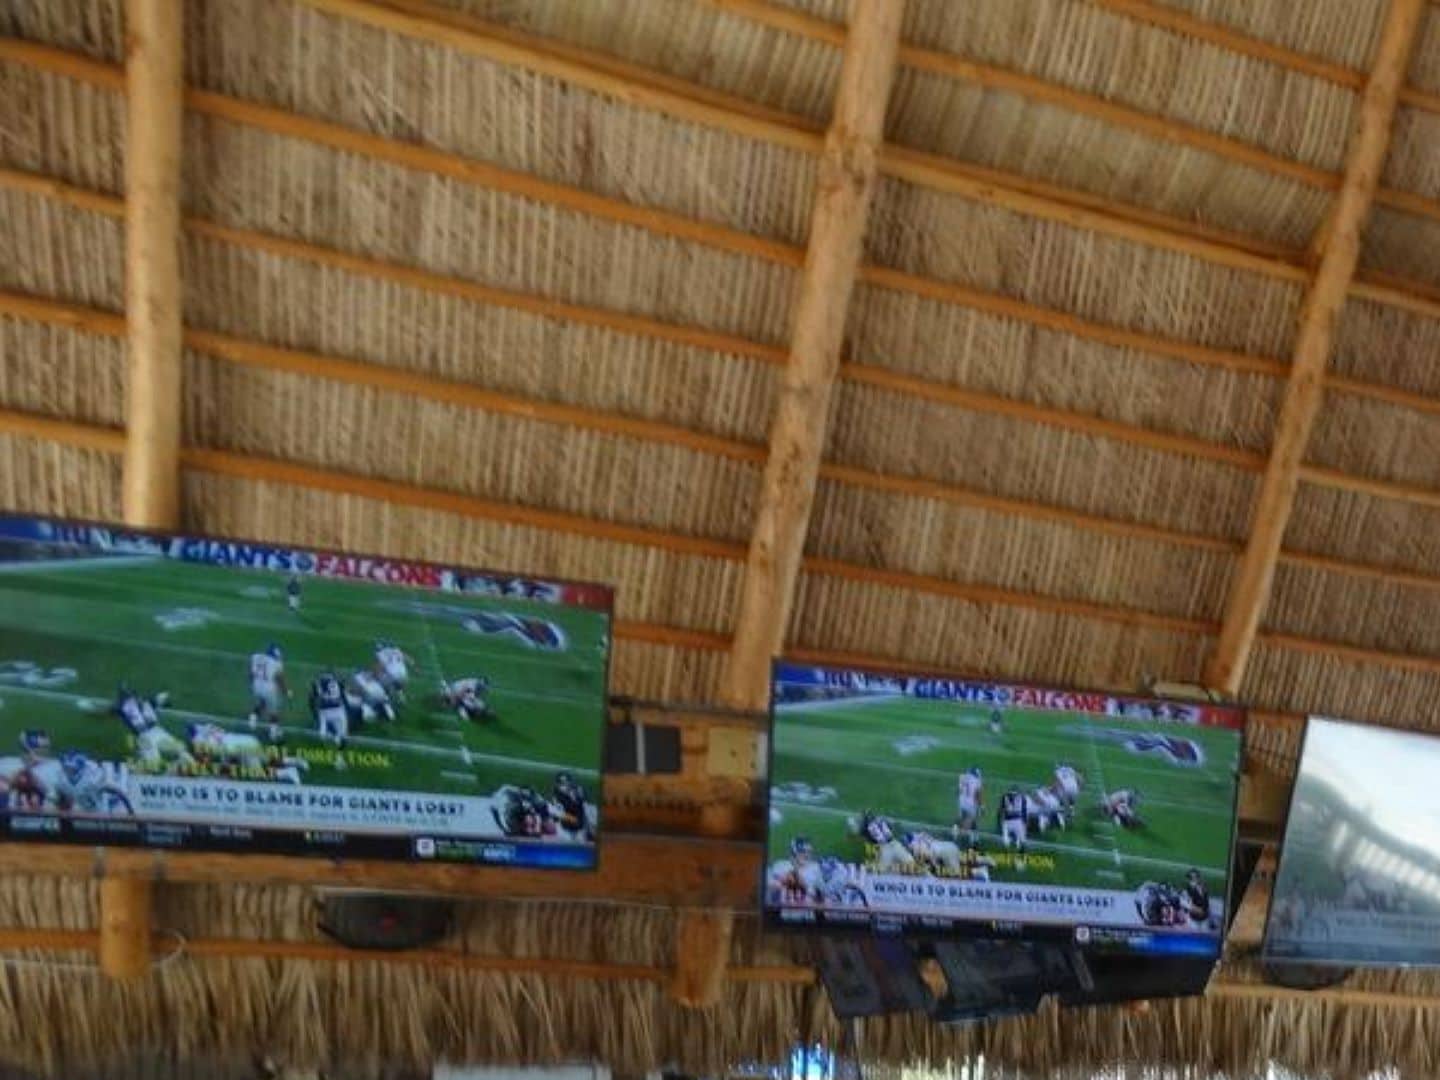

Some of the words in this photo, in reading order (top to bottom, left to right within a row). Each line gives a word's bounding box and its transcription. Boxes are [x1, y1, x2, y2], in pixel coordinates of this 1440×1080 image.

[186, 539, 294, 570] GIANTS
[315, 555, 441, 590] FALCONS
[917, 680, 997, 702] GIANTS
[1013, 687, 1107, 714] FALCONS
[140, 783, 186, 799] WHO
[192, 787, 209, 801] IS
[216, 787, 239, 802] TO
[246, 790, 302, 807] BLAME
[308, 793, 344, 809] FOR
[350, 795, 410, 813] GIANTS
[873, 882, 907, 894] WHO
[911, 884, 923, 896] IS
[928, 885, 945, 897] TO
[950, 886, 992, 900] BLAME
[996, 889, 1022, 902] FOR
[1026, 892, 1074, 905] GIANTS
